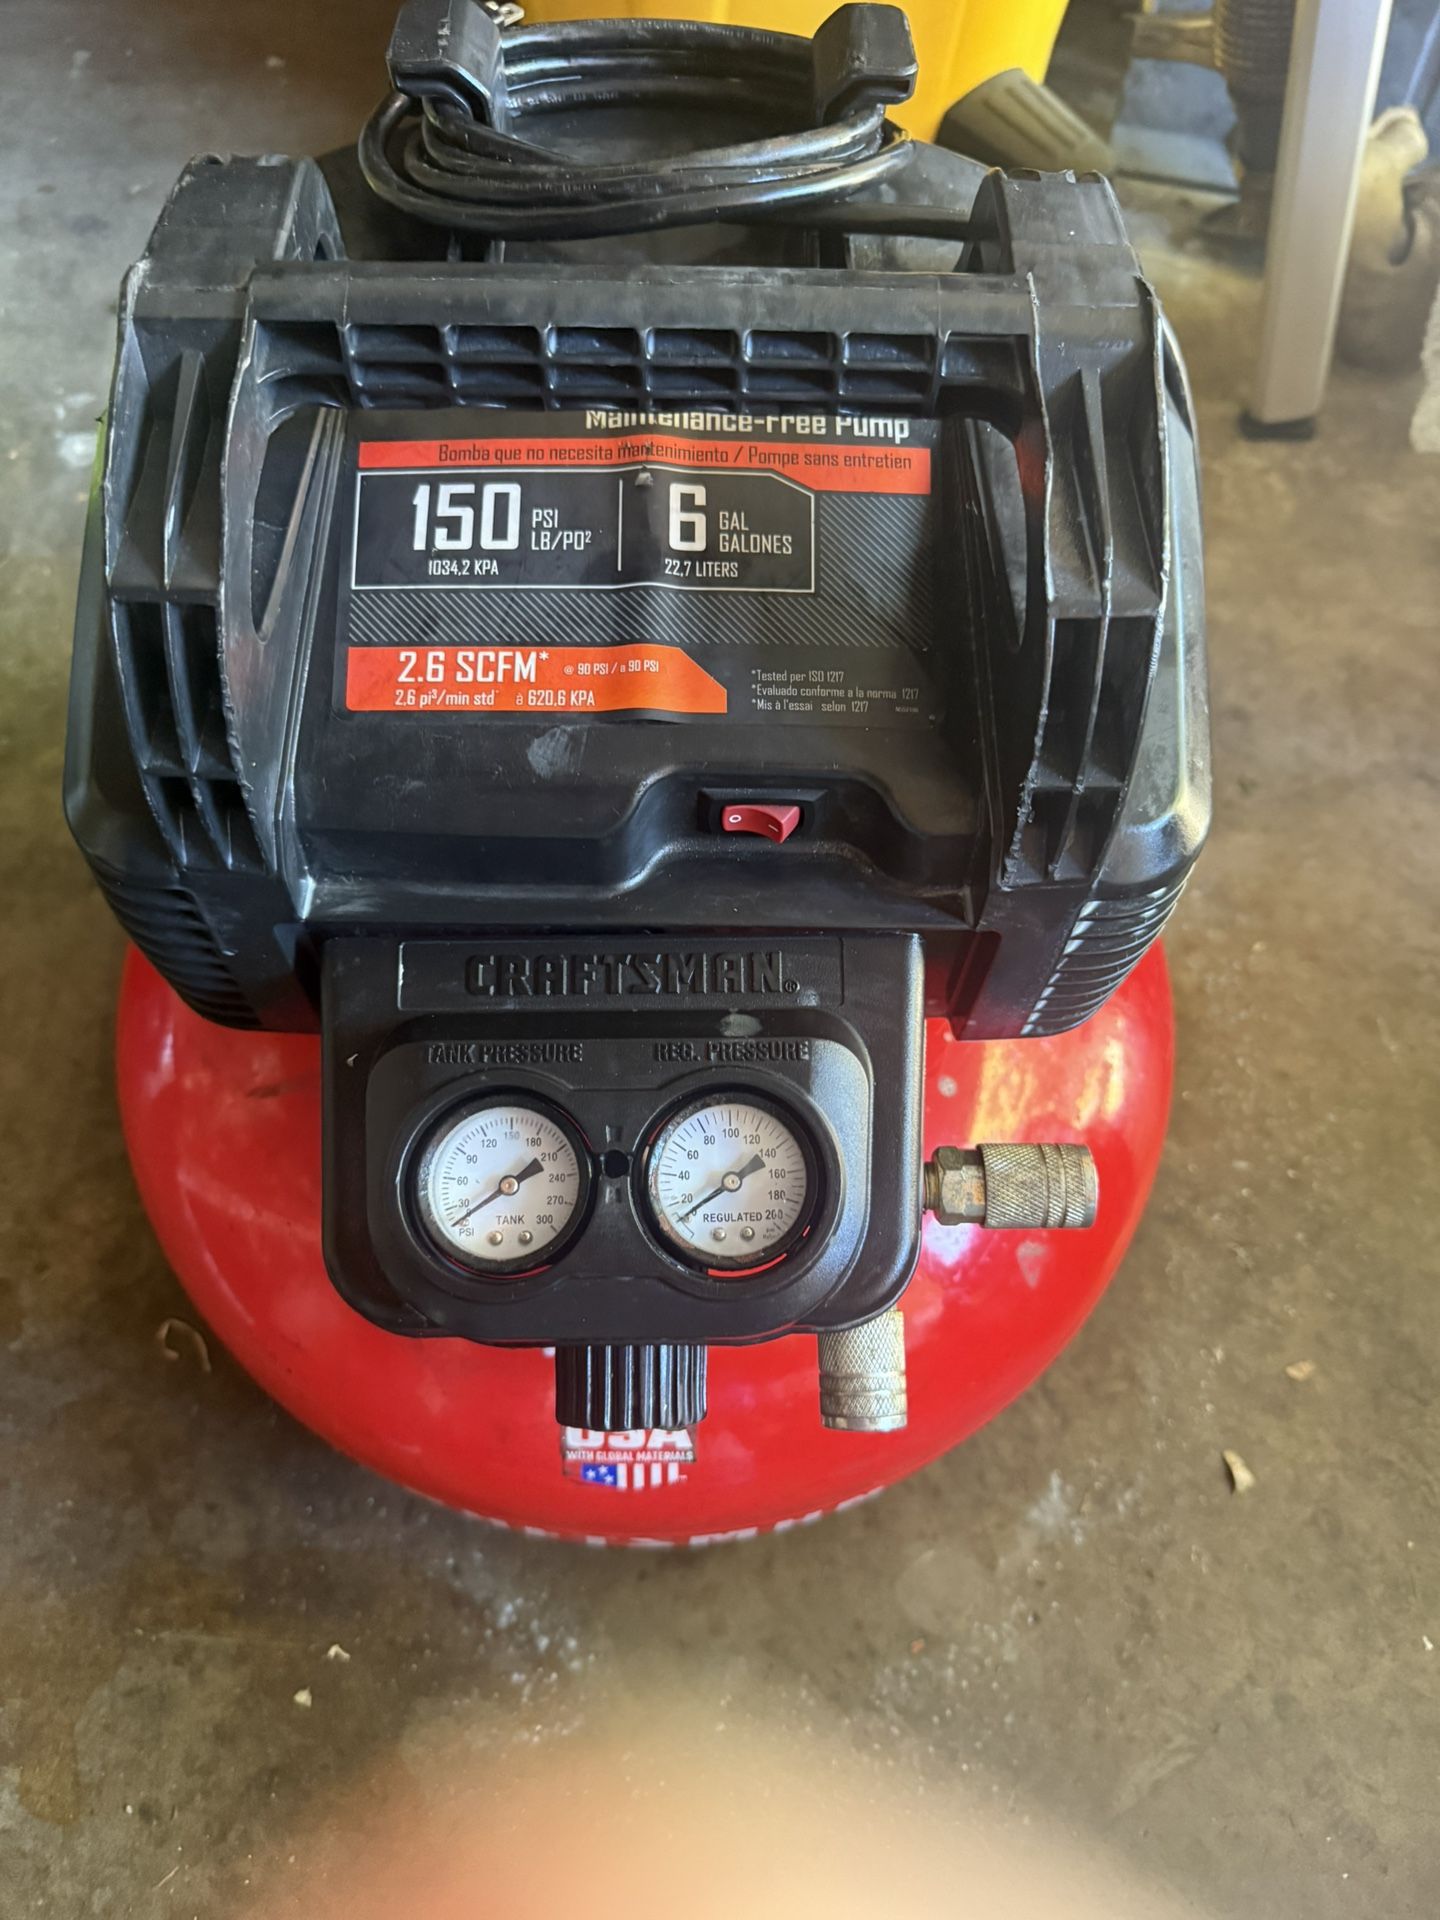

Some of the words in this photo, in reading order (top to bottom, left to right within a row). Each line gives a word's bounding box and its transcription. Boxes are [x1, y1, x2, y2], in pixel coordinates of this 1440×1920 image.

[836, 415, 909, 444] Pump
[438, 443, 490, 462] Bomba
[494, 447, 522, 464] que
[526, 448, 545, 461] no
[549, 444, 613, 461] necesita
[618, 442, 728, 463] mantenimiento
[733, 446, 744, 463] /
[748, 446, 799, 467] Pompe
[804, 454, 839, 467] sans
[843, 453, 912, 470] entretien
[413, 483, 522, 551] 150
[532, 508, 559, 529] PSI
[669, 483, 706, 551] 6
[719, 511, 749, 531] GAL
[719, 534, 792, 555] GALONES
[474, 559, 499, 576] KPA
[695, 561, 739, 578] LITERS
[397, 651, 446, 683] 2.6
[577, 662, 591, 676] 90
[593, 663, 609, 676] PSI
[628, 659, 641, 673] 90
[643, 659, 659, 673] PSI
[790, 671, 807, 684] per
[809, 670, 824, 682] ISO
[827, 671, 844, 683] 1217
[570, 689, 596, 706] KPA
[801, 686, 845, 698] conforme
[847, 690, 853, 698] a
[856, 686, 864, 699] la
[867, 690, 897, 700] norma
[902, 687, 919, 700] 1217
[821, 700, 846, 713] selon
[851, 700, 869, 713] 1217
[426, 1042, 476, 1064] TANK
[480, 1042, 583, 1064] PRESSURE
[655, 1041, 701, 1063] REG.
[704, 1040, 809, 1063] PRESSURE
[504, 1131, 520, 1141] 150
[723, 1127, 740, 1138] 100
[481, 1138, 498, 1149] 120
[526, 1137, 542, 1148] 180
[703, 1135, 716, 1146] 80
[744, 1134, 761, 1145] 120
[541, 1152, 558, 1163] 210
[687, 1149, 699, 1160] 60
[760, 1148, 777, 1159] 140
[466, 1154, 478, 1165] 90
[549, 1173, 566, 1184] 240
[678, 1170, 690, 1181] 40
[769, 1168, 786, 1179] 160
[457, 1176, 469, 1186] 60
[547, 1195, 564, 1206] 270
[681, 1193, 693, 1204] 20
[768, 1190, 786, 1201] 180
[458, 1198, 470, 1208] 30
[536, 1214, 554, 1226] 300
[703, 1212, 763, 1223] REGULATED
[765, 1209, 784, 1220] 200
[496, 1215, 525, 1226] TANK
[459, 1227, 475, 1238] PSI
[566, 1450, 594, 1461] WITH
[596, 1450, 634, 1462] GLOBAL
[636, 1450, 694, 1462] MATERIALS
